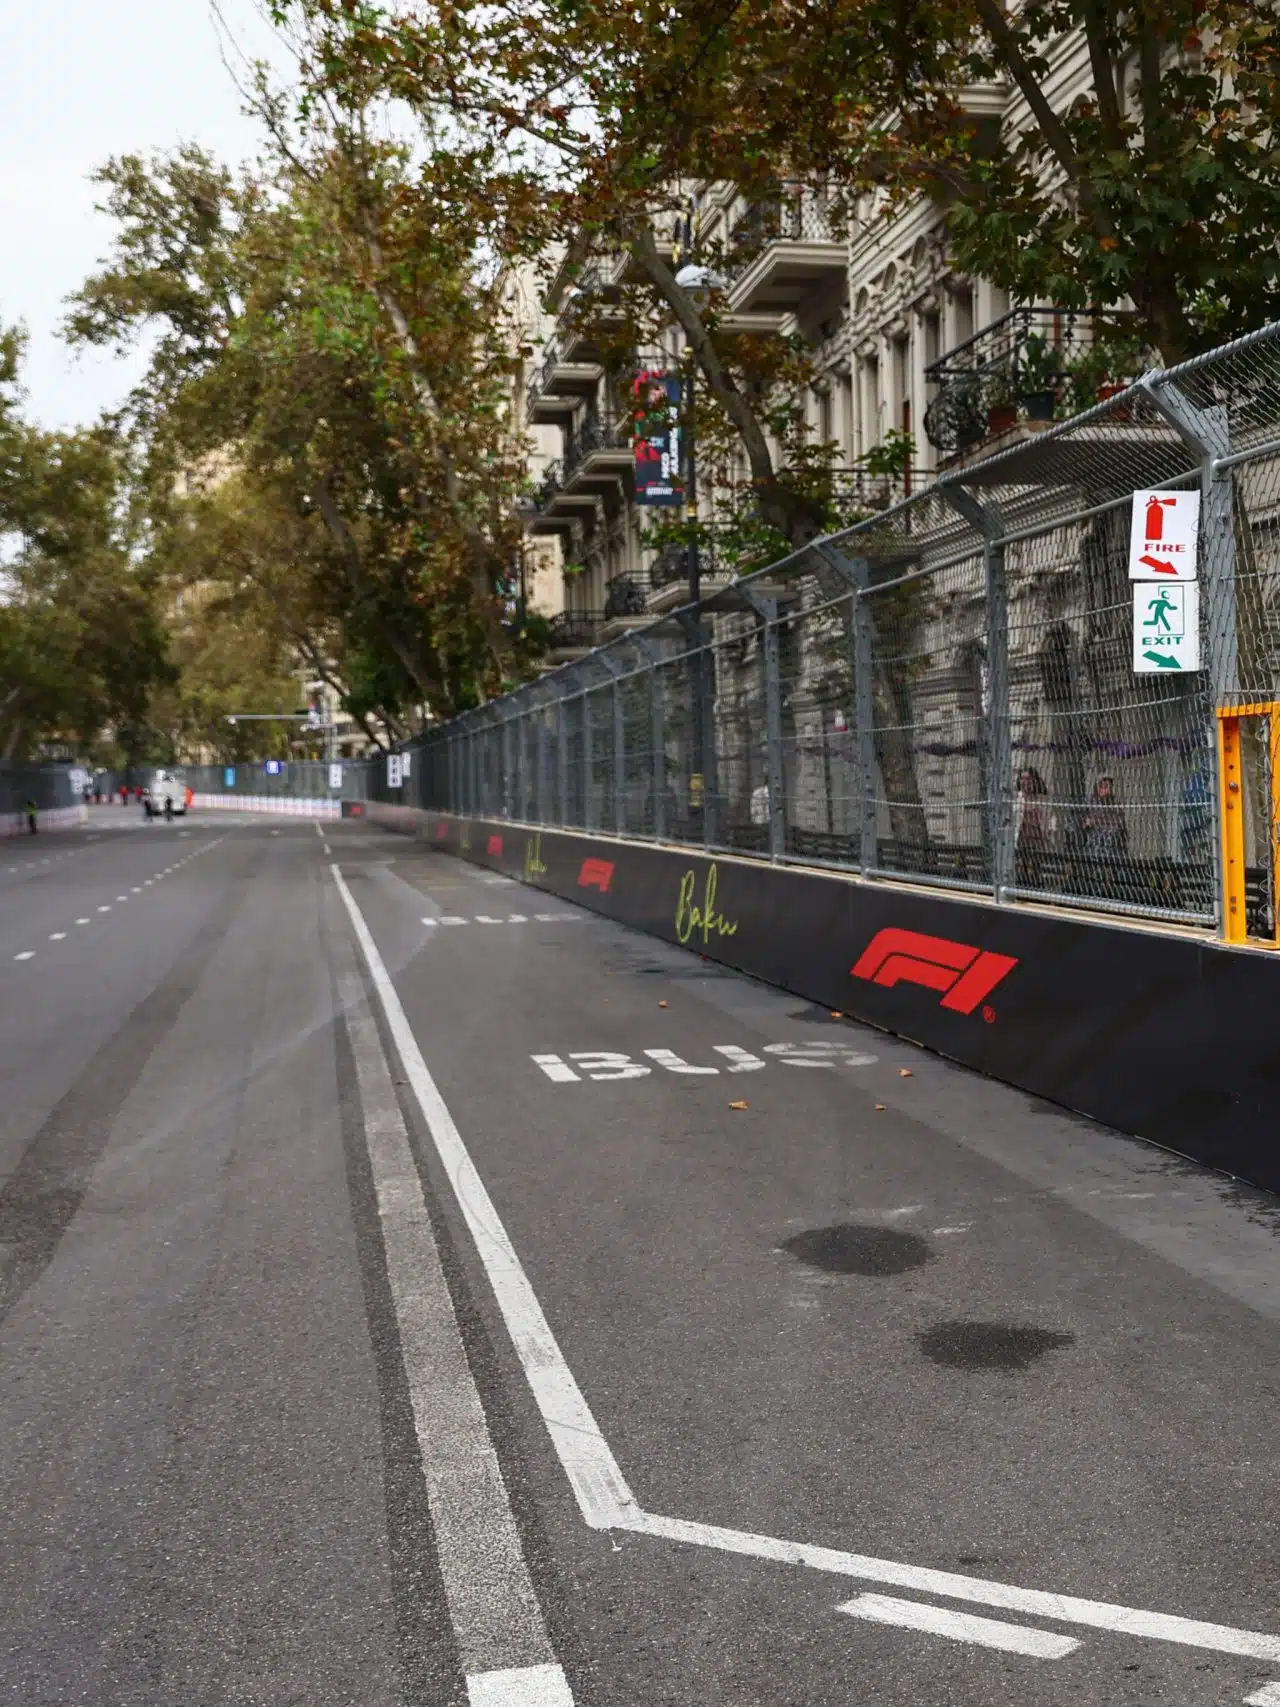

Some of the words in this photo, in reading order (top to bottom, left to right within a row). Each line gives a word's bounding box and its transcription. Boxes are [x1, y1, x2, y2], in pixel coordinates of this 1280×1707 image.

[1143, 543, 1187, 553] FIRE
[1141, 636, 1184, 646] EXIT
[675, 862, 739, 945] Baku
[849, 927, 1020, 1016] F1
[529, 1040, 880, 1083] BUS
